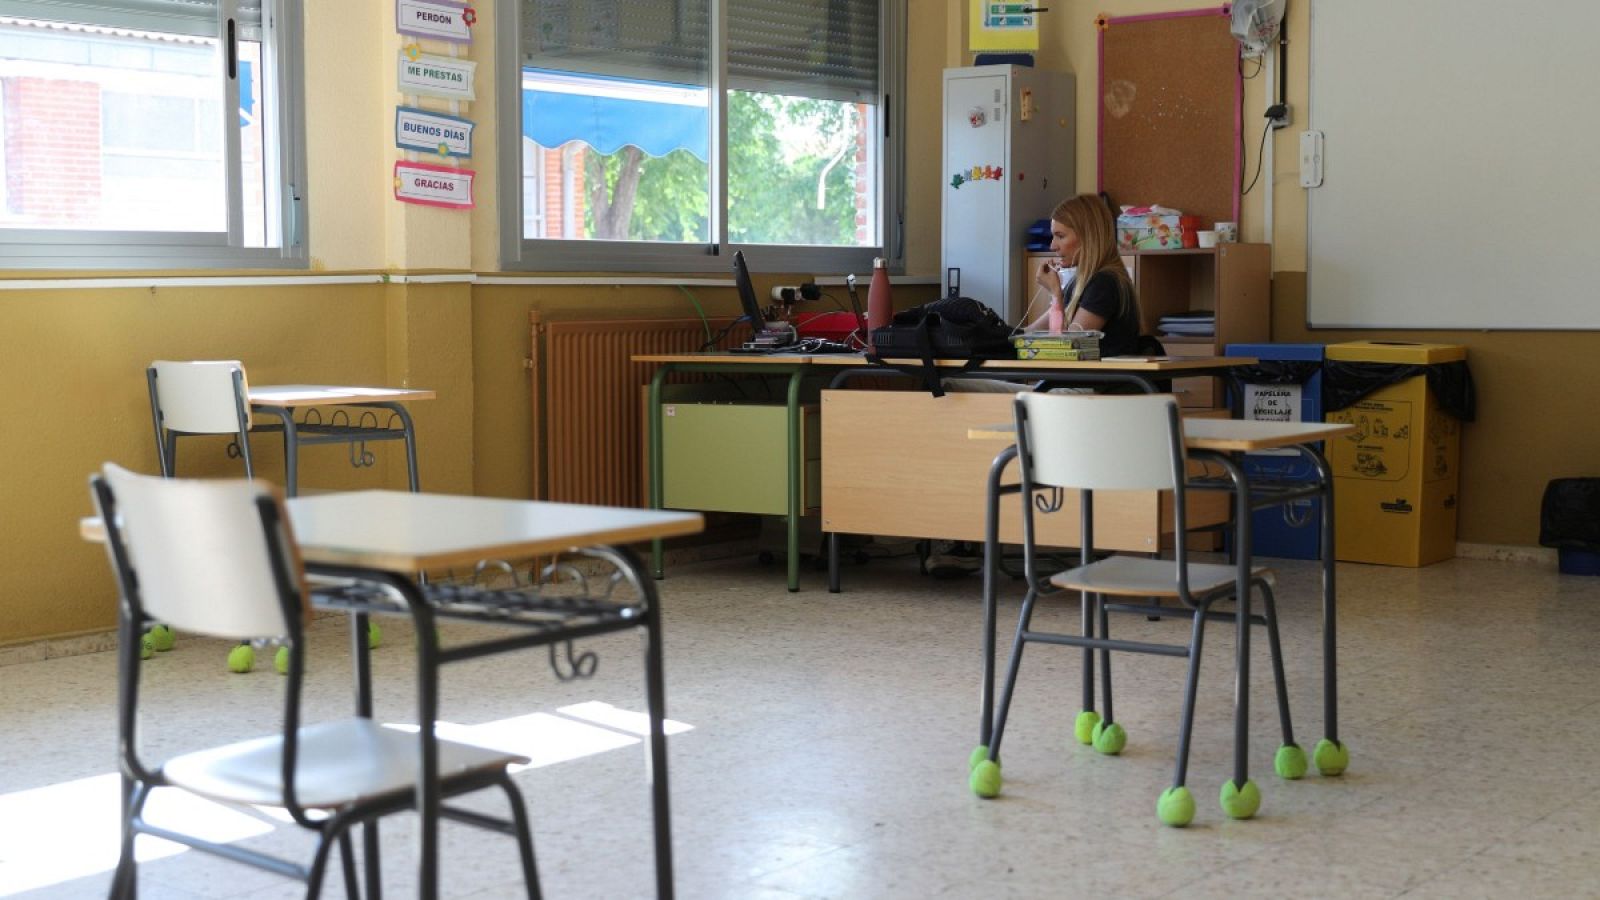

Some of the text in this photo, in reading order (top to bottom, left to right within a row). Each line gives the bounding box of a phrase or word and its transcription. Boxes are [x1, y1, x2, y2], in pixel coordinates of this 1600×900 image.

[408, 66, 462, 82] ME PRESTAS
[404, 123, 440, 136] BUENOS
[415, 179, 454, 191] GRACIAS
